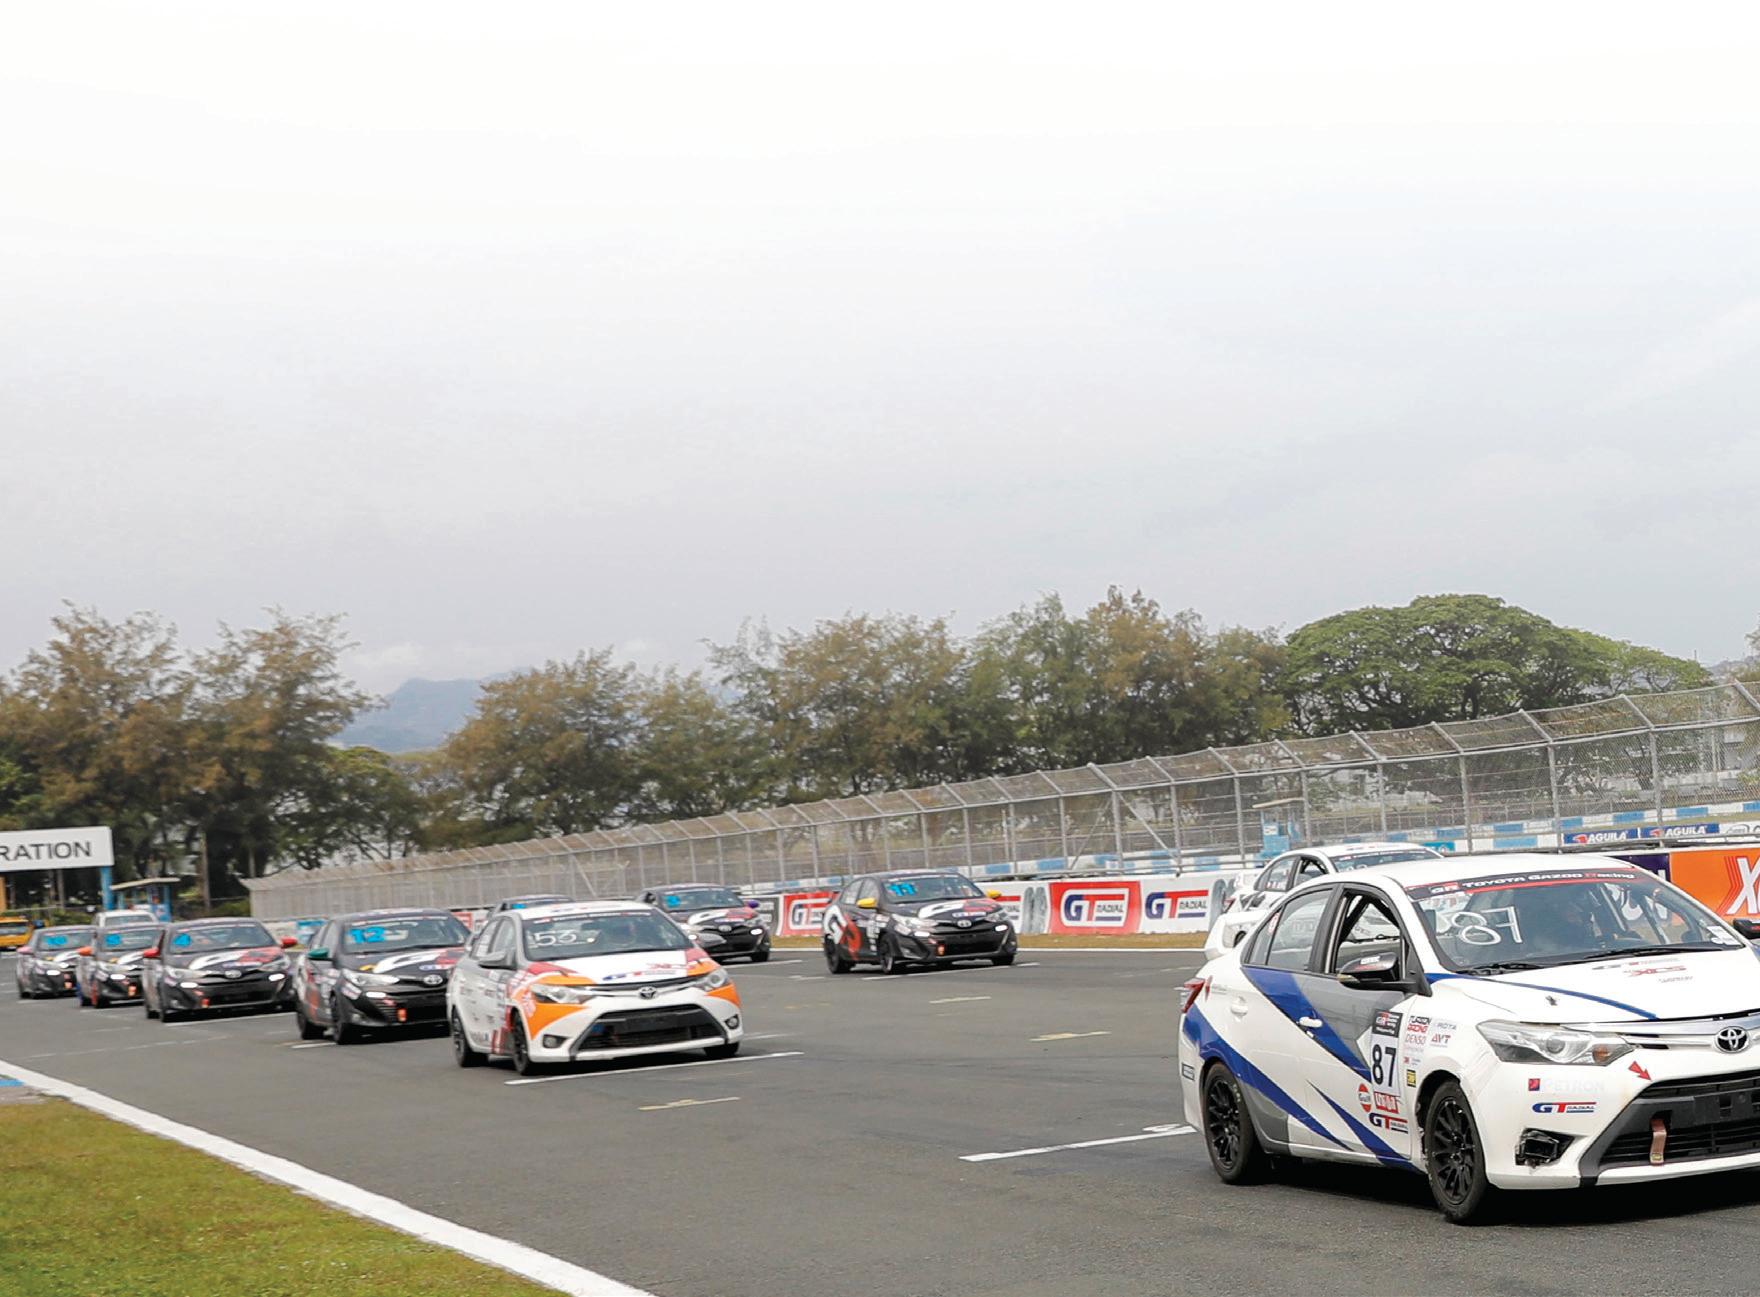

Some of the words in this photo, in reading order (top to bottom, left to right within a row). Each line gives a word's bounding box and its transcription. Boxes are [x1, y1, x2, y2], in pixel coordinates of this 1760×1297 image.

[1587, 832, 1628, 844] AGUILA
[1665, 826, 1707, 838] AGUILA
[1463, 876, 1525, 888] TOYOTA
[1063, 894, 1108, 921] GT
[1145, 890, 1191, 918] GT
[351, 926, 385, 943] 12
[1452, 906, 1523, 946] 87
[1372, 1044, 1397, 1087] 87
[1532, 1102, 1575, 1113] GT
[1369, 1112, 1396, 1130] GT
